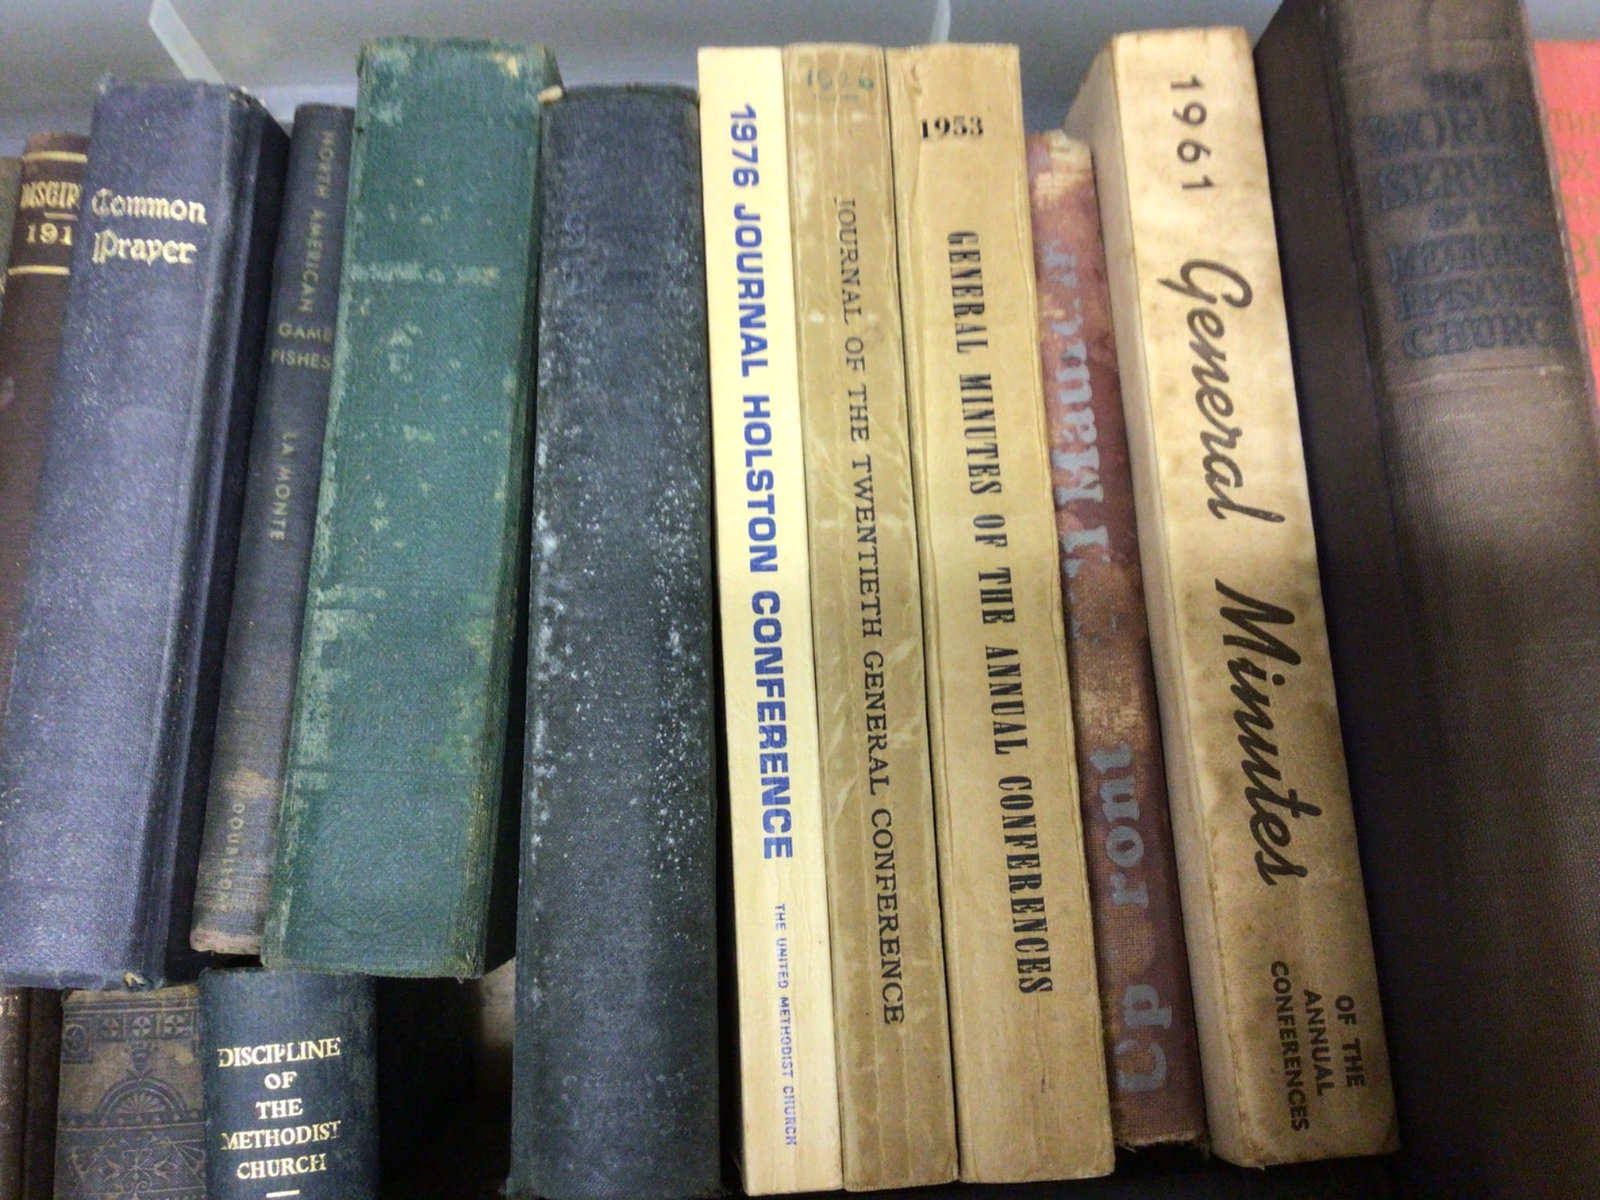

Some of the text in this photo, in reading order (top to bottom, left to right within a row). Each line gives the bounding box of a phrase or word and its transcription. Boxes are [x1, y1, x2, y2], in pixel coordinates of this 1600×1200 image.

[921, 115, 984, 140] 1953
[1170, 75, 1214, 191] 1961
[91, 187, 207, 225] Common
[92, 228, 197, 265] Prayer
[300, 207, 327, 312] AMERICAN
[270, 348, 331, 371] FISHES
[277, 321, 334, 344] GAME
[268, 431, 298, 541] LA MONTE
[730, 103, 793, 859] 1976 JOURNAL HOLSTON CONFERENCE
[833, 197, 905, 1025] JOURNAL OF THE TWENTIETH GENERAL CONFERENCE
[947, 230, 1053, 995] GENERAL MINUTES OF THE ANNUAL CONFERENCES
[1158, 258, 1322, 885] General Minutes
[217, 1037, 341, 1067] DISCIPLINE
[774, 903, 797, 1146] THE UNITED METHODIST CHURCH
[1271, 960, 1310, 1131] CONFERENCES
[1304, 989, 1335, 1096] ANNUAL
[1335, 995, 1367, 1088] OF THE
[256, 1098, 303, 1119] THE
[264, 1071, 297, 1089] OF
[221, 1120, 341, 1150] METHODIST
[237, 1153, 327, 1179] CHURCH
